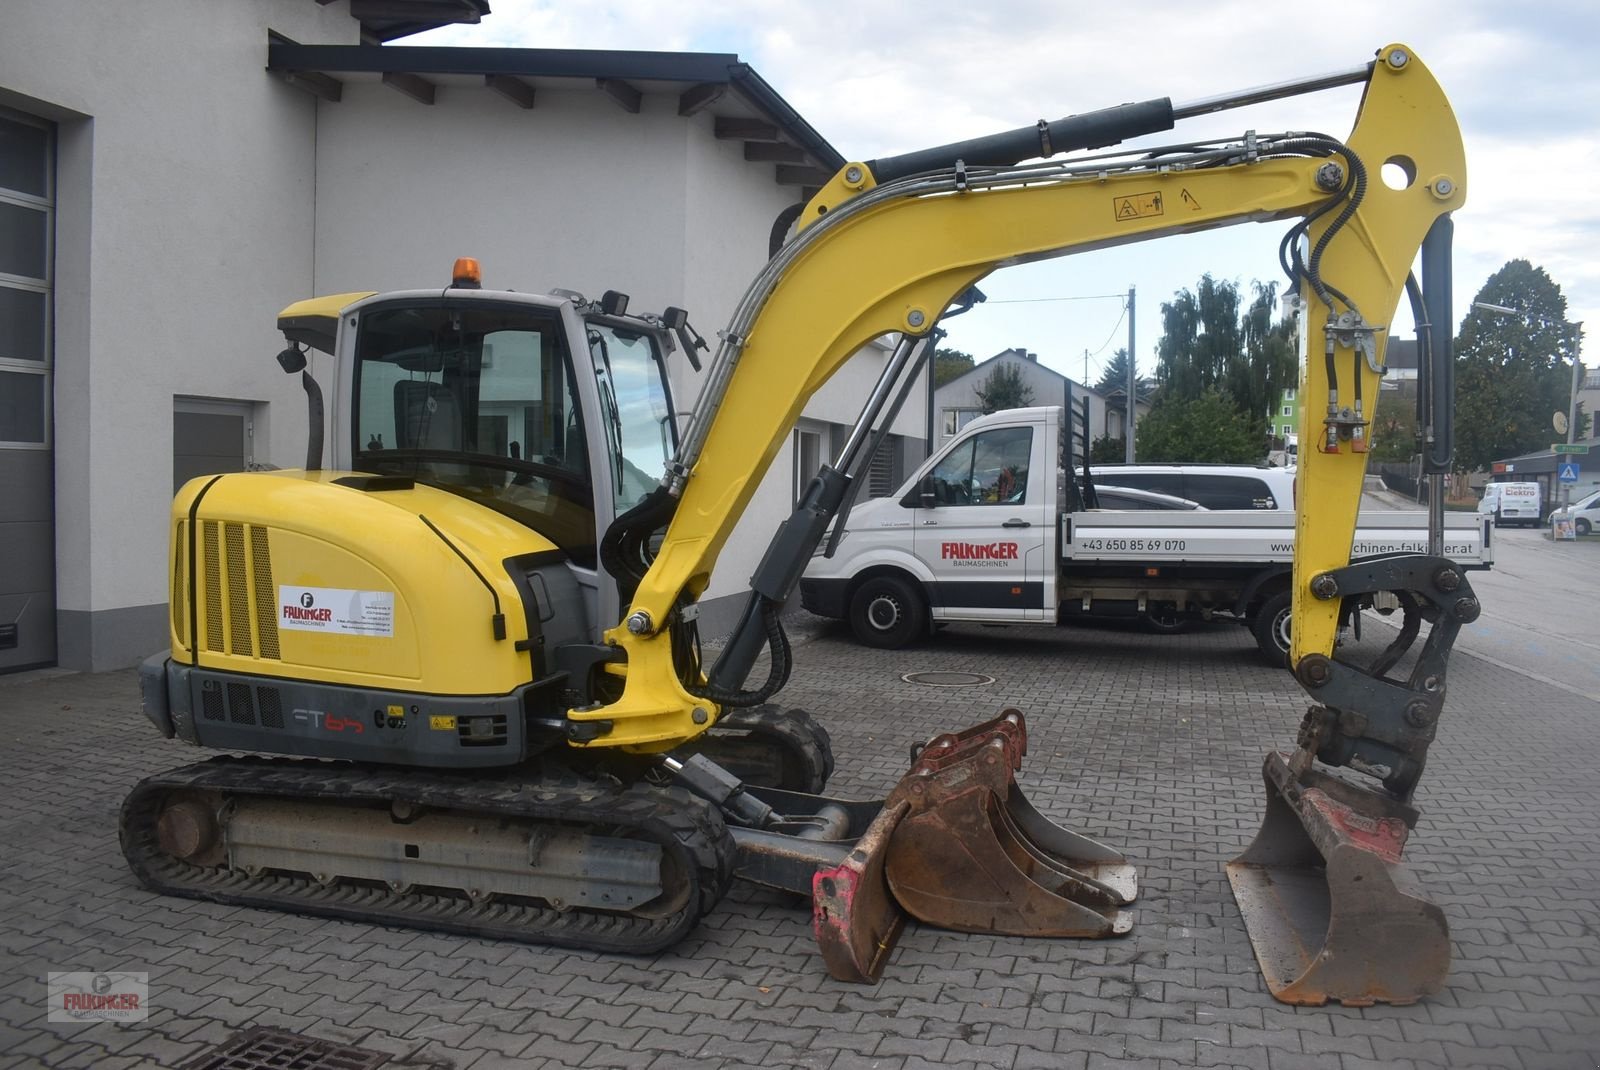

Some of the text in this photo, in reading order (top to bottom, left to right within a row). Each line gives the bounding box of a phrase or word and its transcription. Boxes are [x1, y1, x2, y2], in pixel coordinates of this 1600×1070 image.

[941, 542, 1018, 559] FALKINGER
[1082, 540, 1186, 551] +43 650 85 69 070
[283, 606, 331, 622] FALKINGER
[289, 619, 326, 627] BAUMASCHINEN
